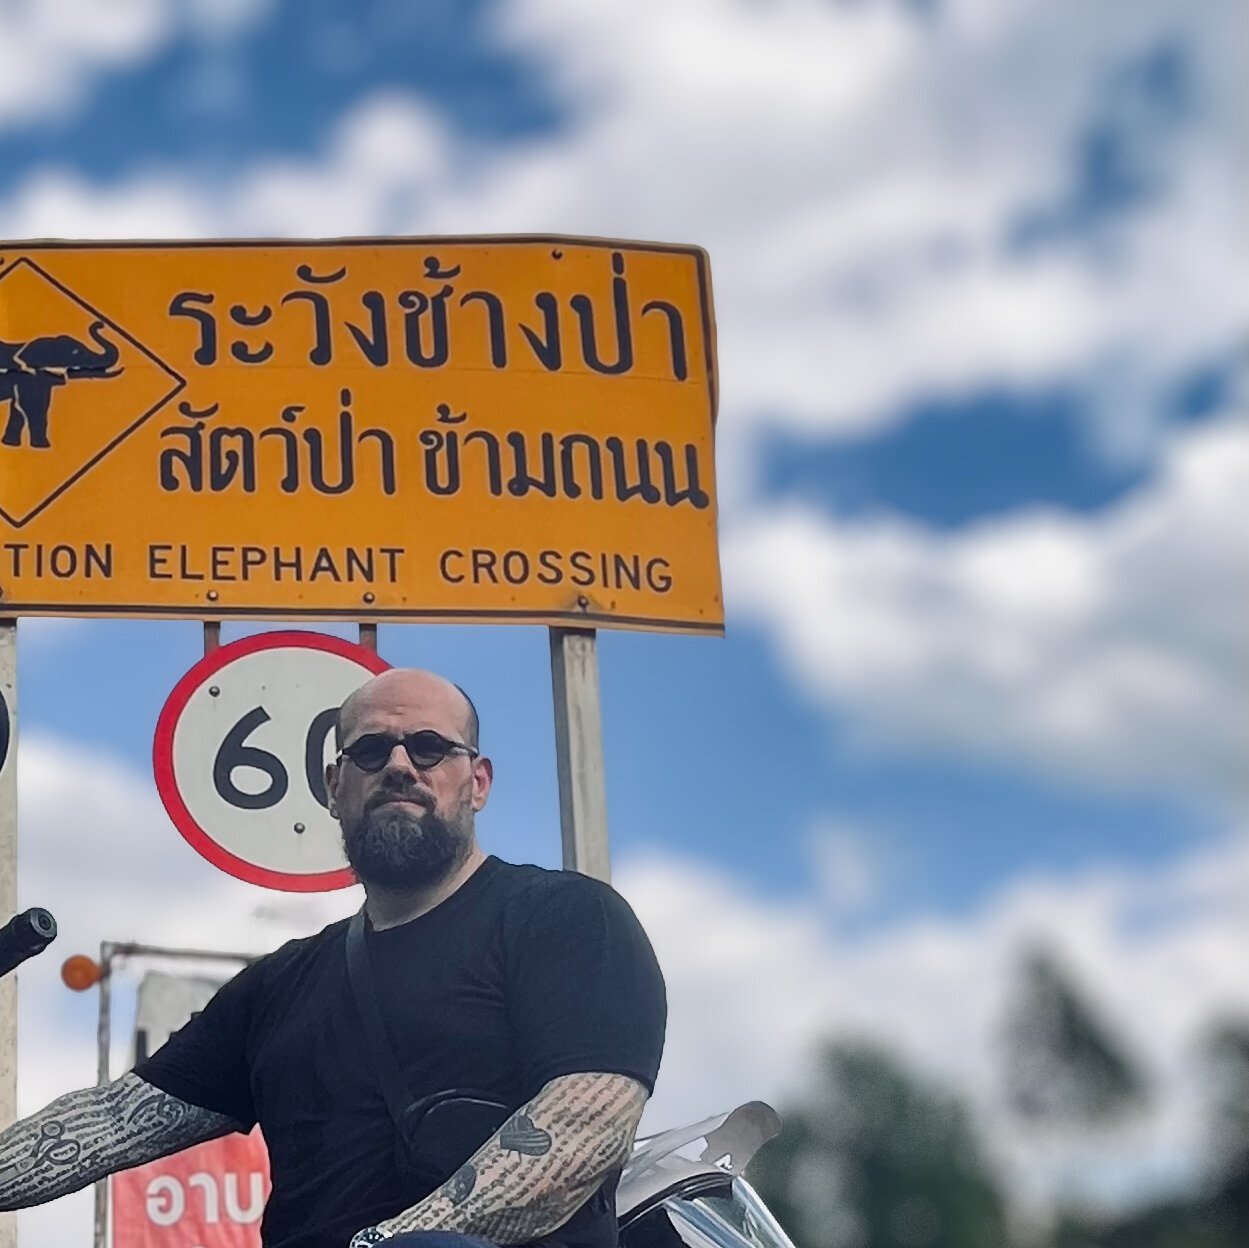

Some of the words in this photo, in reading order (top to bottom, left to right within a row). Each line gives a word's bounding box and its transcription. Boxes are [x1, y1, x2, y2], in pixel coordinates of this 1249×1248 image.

[169, 252, 689, 381] ระวังช้างป่า
[159, 388, 398, 496] สัตว์ป่า
[419, 403, 710, 510] ข้ามถนน
[149, 545, 406, 583] ELEPHANT
[439, 549, 673, 593] CROSSING
